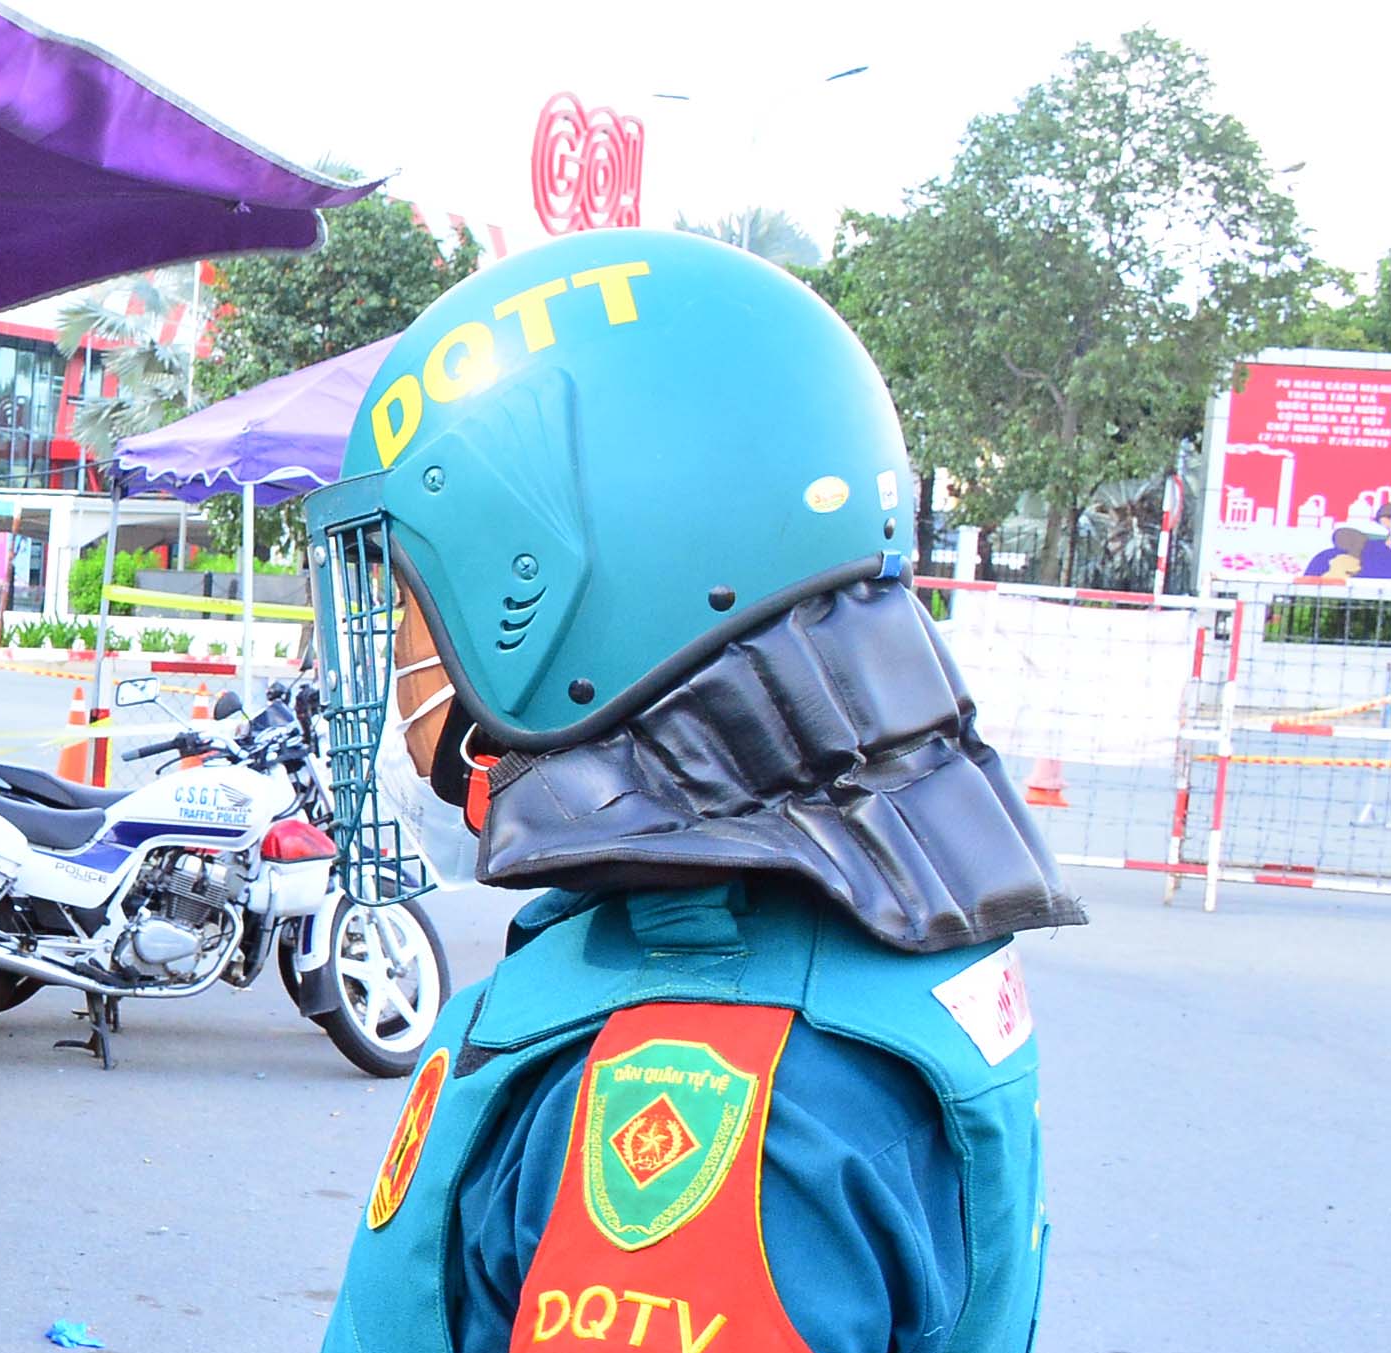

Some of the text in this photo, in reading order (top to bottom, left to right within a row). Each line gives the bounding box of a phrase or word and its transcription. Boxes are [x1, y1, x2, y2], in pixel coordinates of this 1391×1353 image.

[370, 260, 650, 470] DQTT
[179, 807, 247, 824] TRAFFIC POLICE
[55, 862, 107, 884] POLICE
